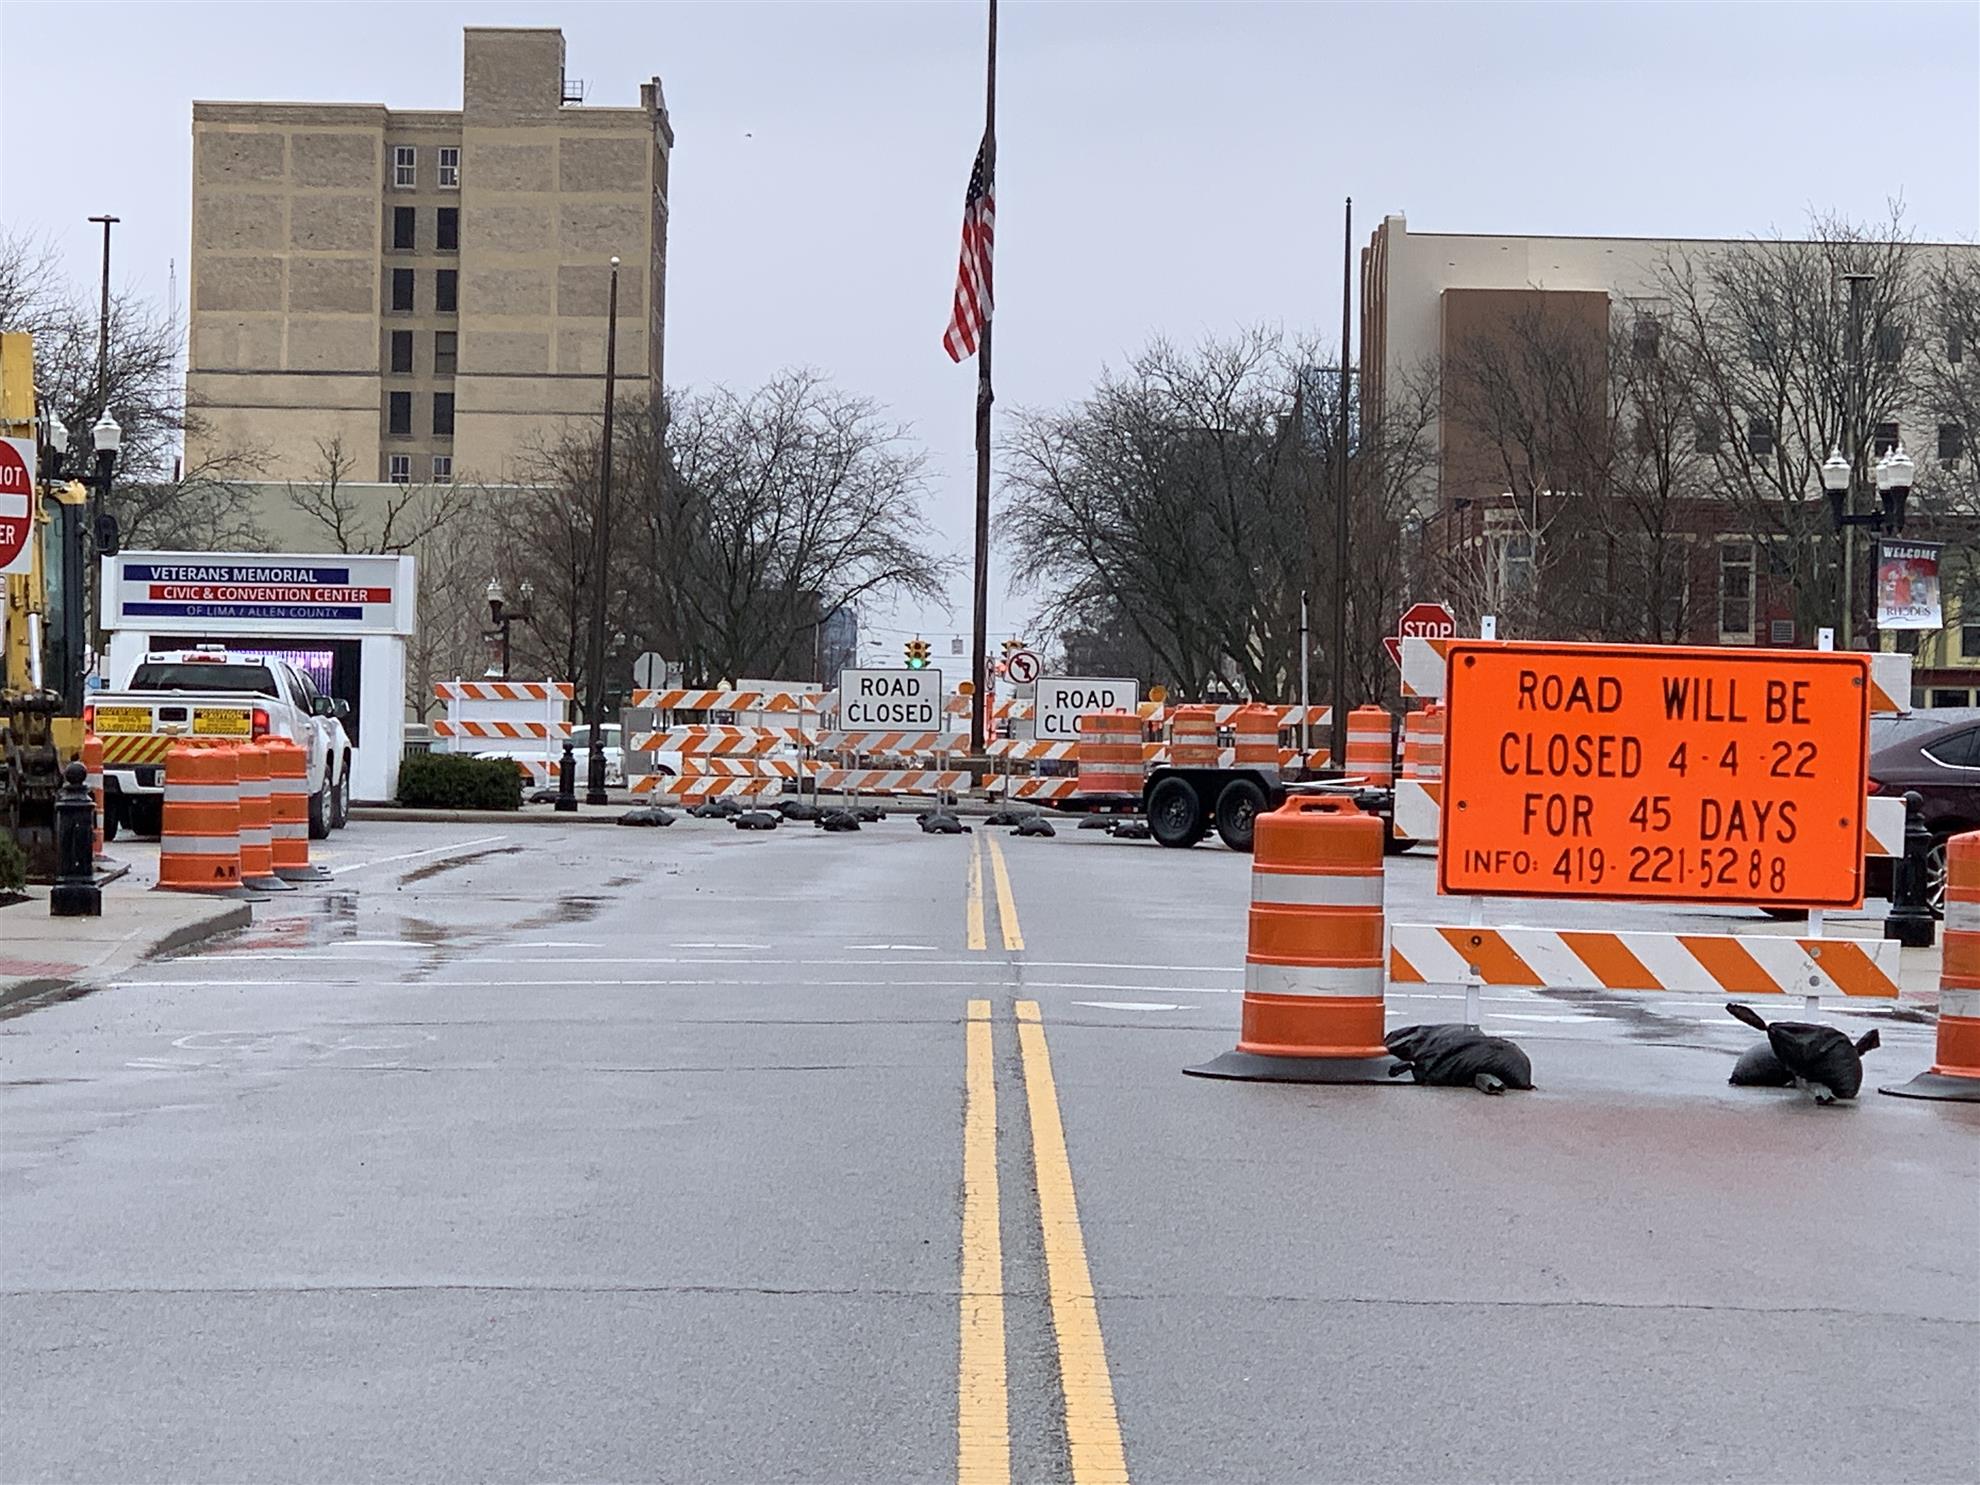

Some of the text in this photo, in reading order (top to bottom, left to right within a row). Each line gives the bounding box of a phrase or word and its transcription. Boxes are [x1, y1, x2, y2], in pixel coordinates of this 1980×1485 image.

[0, 465, 22, 486] OT
[1883, 546, 1937, 560] WELCOME
[150, 567, 317, 582] VETERANS MEMORIAL
[163, 586, 368, 602] CIVIC & CONVENTION CENTER
[186, 606, 203, 616] OF
[206, 606, 236, 616] LIMA
[248, 607, 285, 617] ALLEN
[289, 607, 339, 618] COUNTY
[1404, 621, 1452, 638] STOP
[861, 678, 920, 697] ROAD
[1056, 690, 1115, 709] ROAD
[1518, 670, 1811, 725] ROAD WILL BE
[848, 703, 933, 723] CLOSED
[1044, 714, 1081, 734] CLO
[1500, 731, 1642, 778] CLOSED
[1523, 793, 1797, 843] FOR 45 DAYS
[1464, 849, 1539, 875] INFO:
